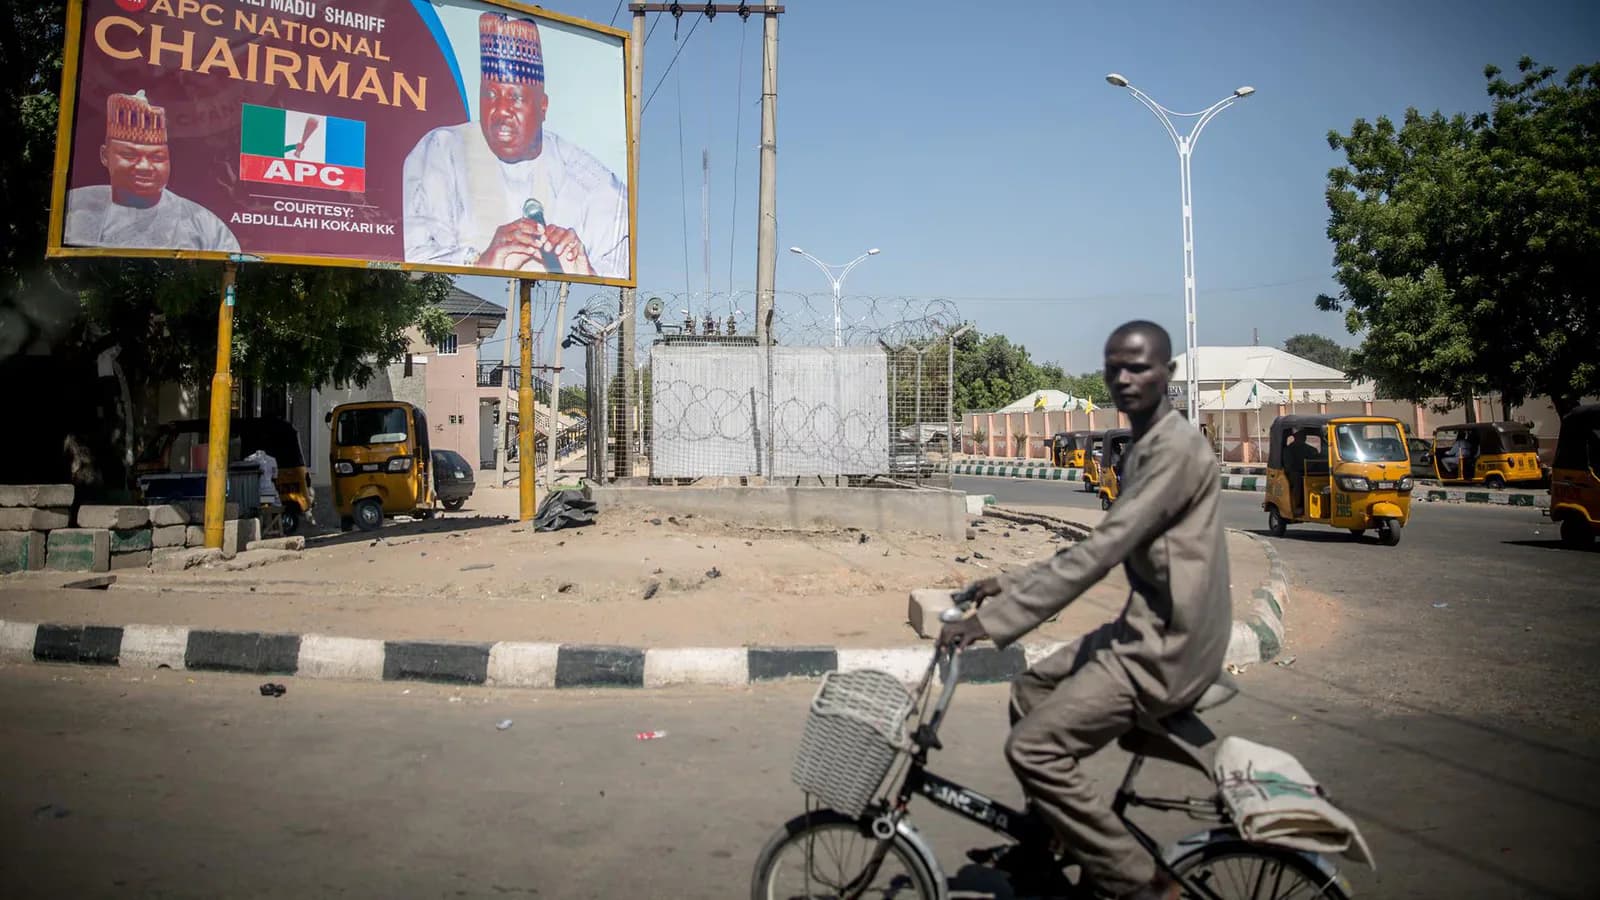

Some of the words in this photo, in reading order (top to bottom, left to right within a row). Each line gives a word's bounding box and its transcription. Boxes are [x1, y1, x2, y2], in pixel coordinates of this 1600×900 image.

[149, 0, 224, 26] APC
[234, 9, 391, 62] NATIONAL
[325, 7, 386, 33] SHARIFF
[94, 15, 428, 112] CHAIRMAN
[263, 160, 345, 187] APC
[274, 200, 355, 218] COURTESY:
[230, 212, 318, 229] ABDULLAHI
[321, 219, 373, 234] KOKARI
[376, 224, 395, 235] KK
